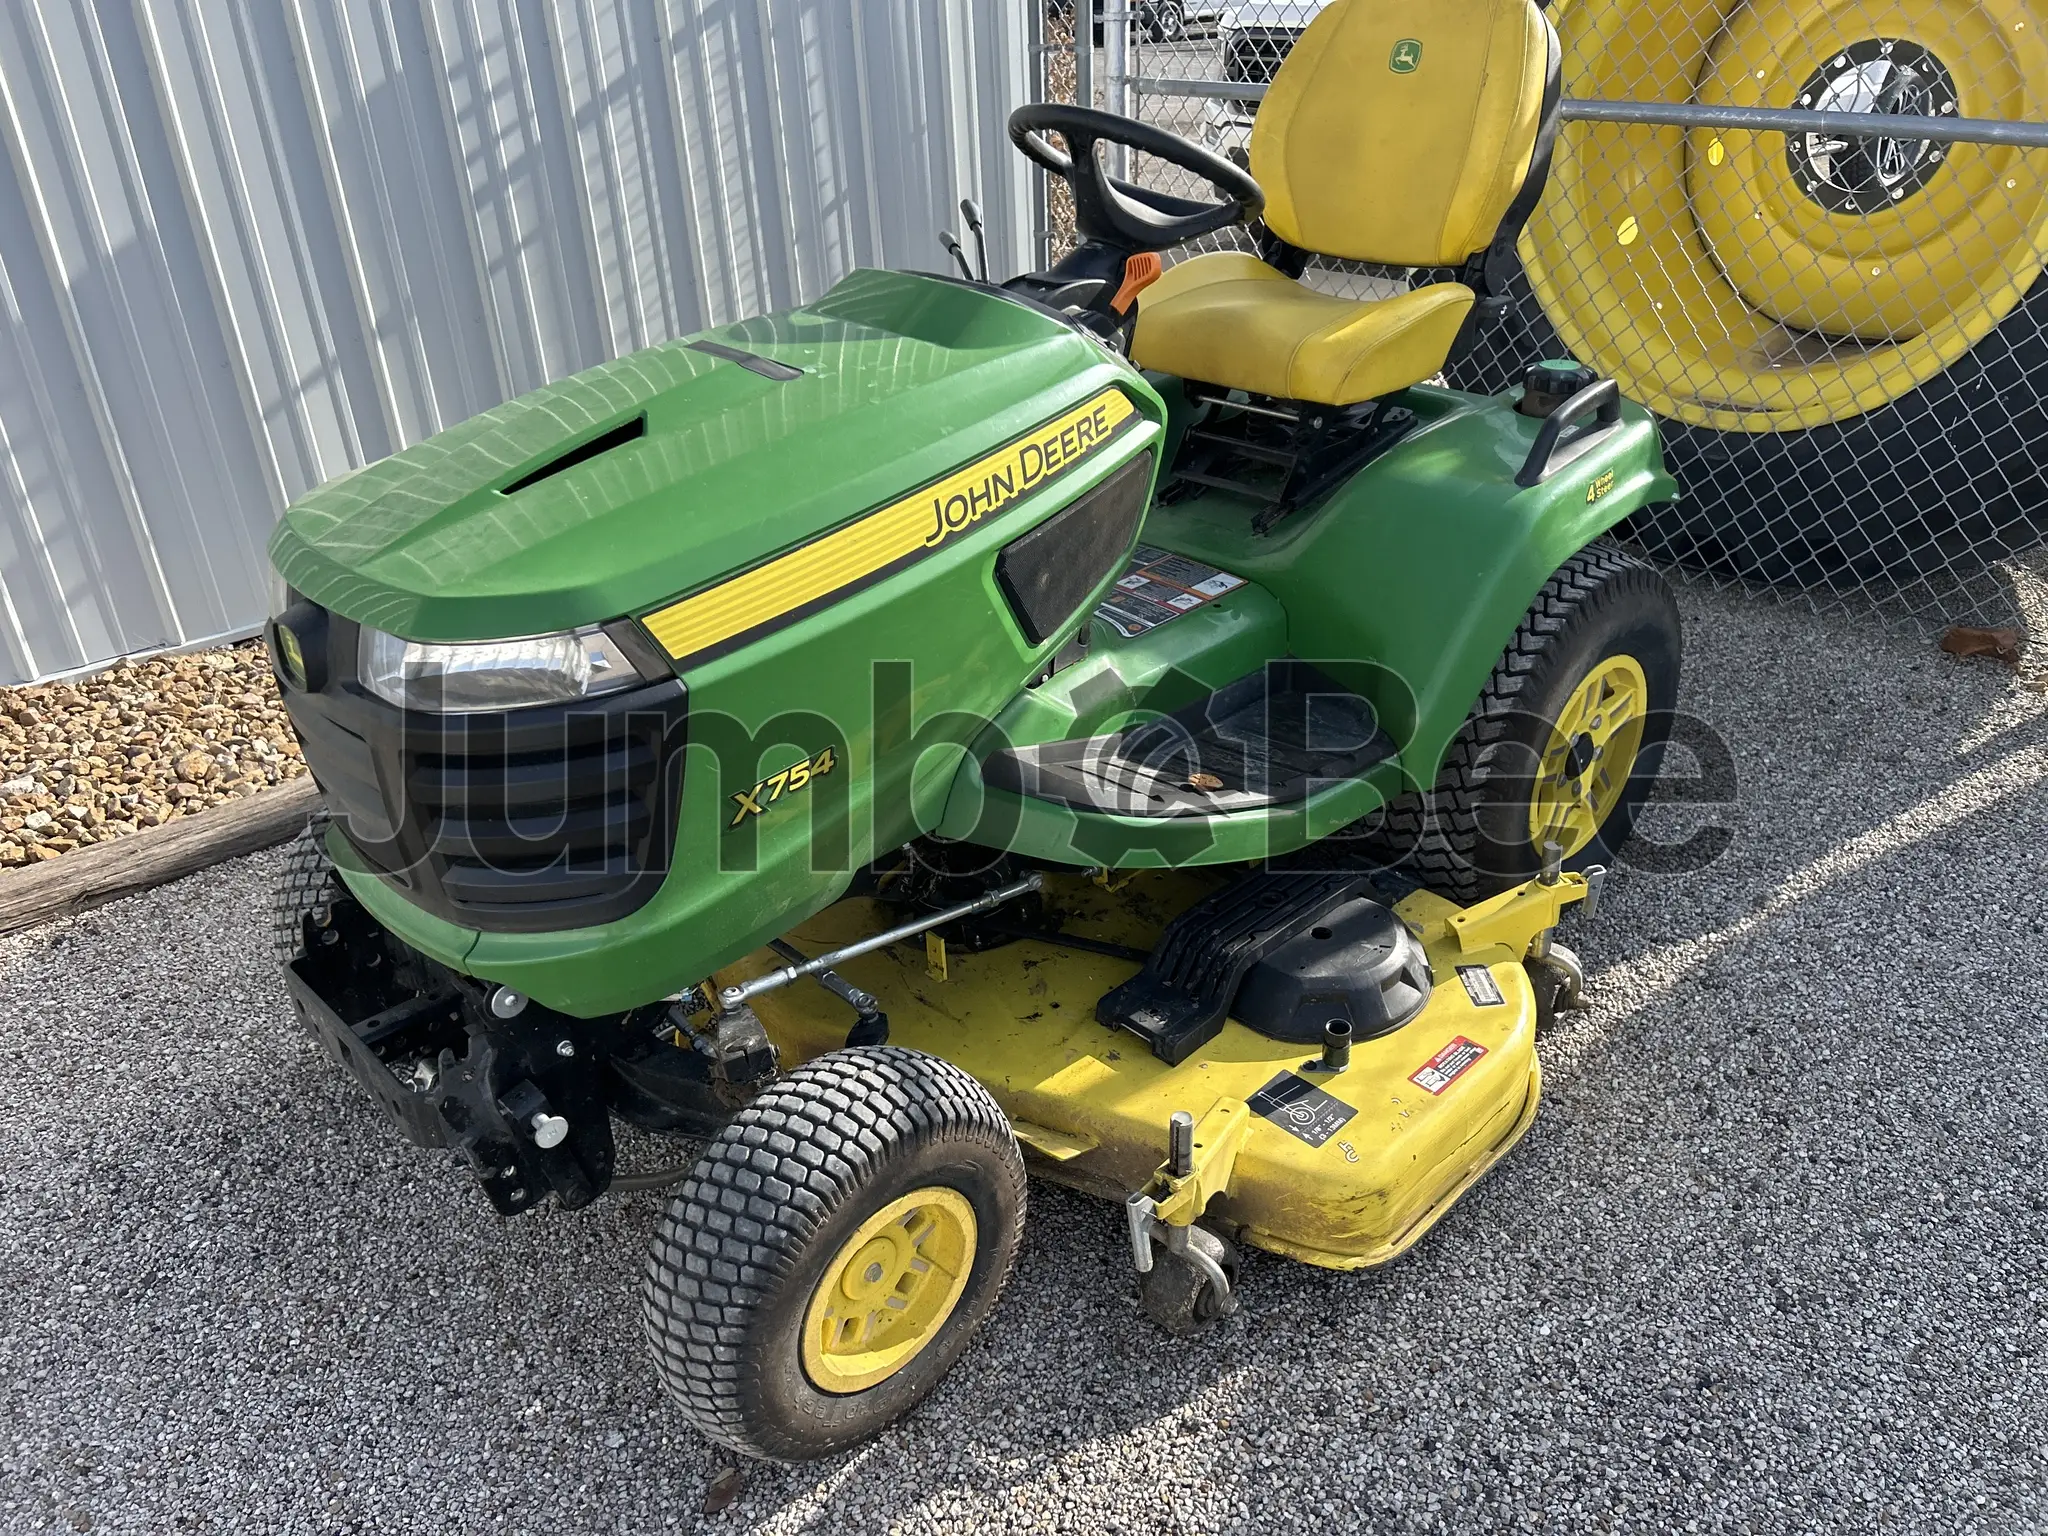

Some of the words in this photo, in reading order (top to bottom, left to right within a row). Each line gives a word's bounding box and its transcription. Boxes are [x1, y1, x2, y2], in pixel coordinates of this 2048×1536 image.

[925, 464, 1015, 544] JOHN
[1019, 403, 1109, 486] DEERE
[1586, 484, 1596, 502] 4
[730, 747, 837, 827] X754
